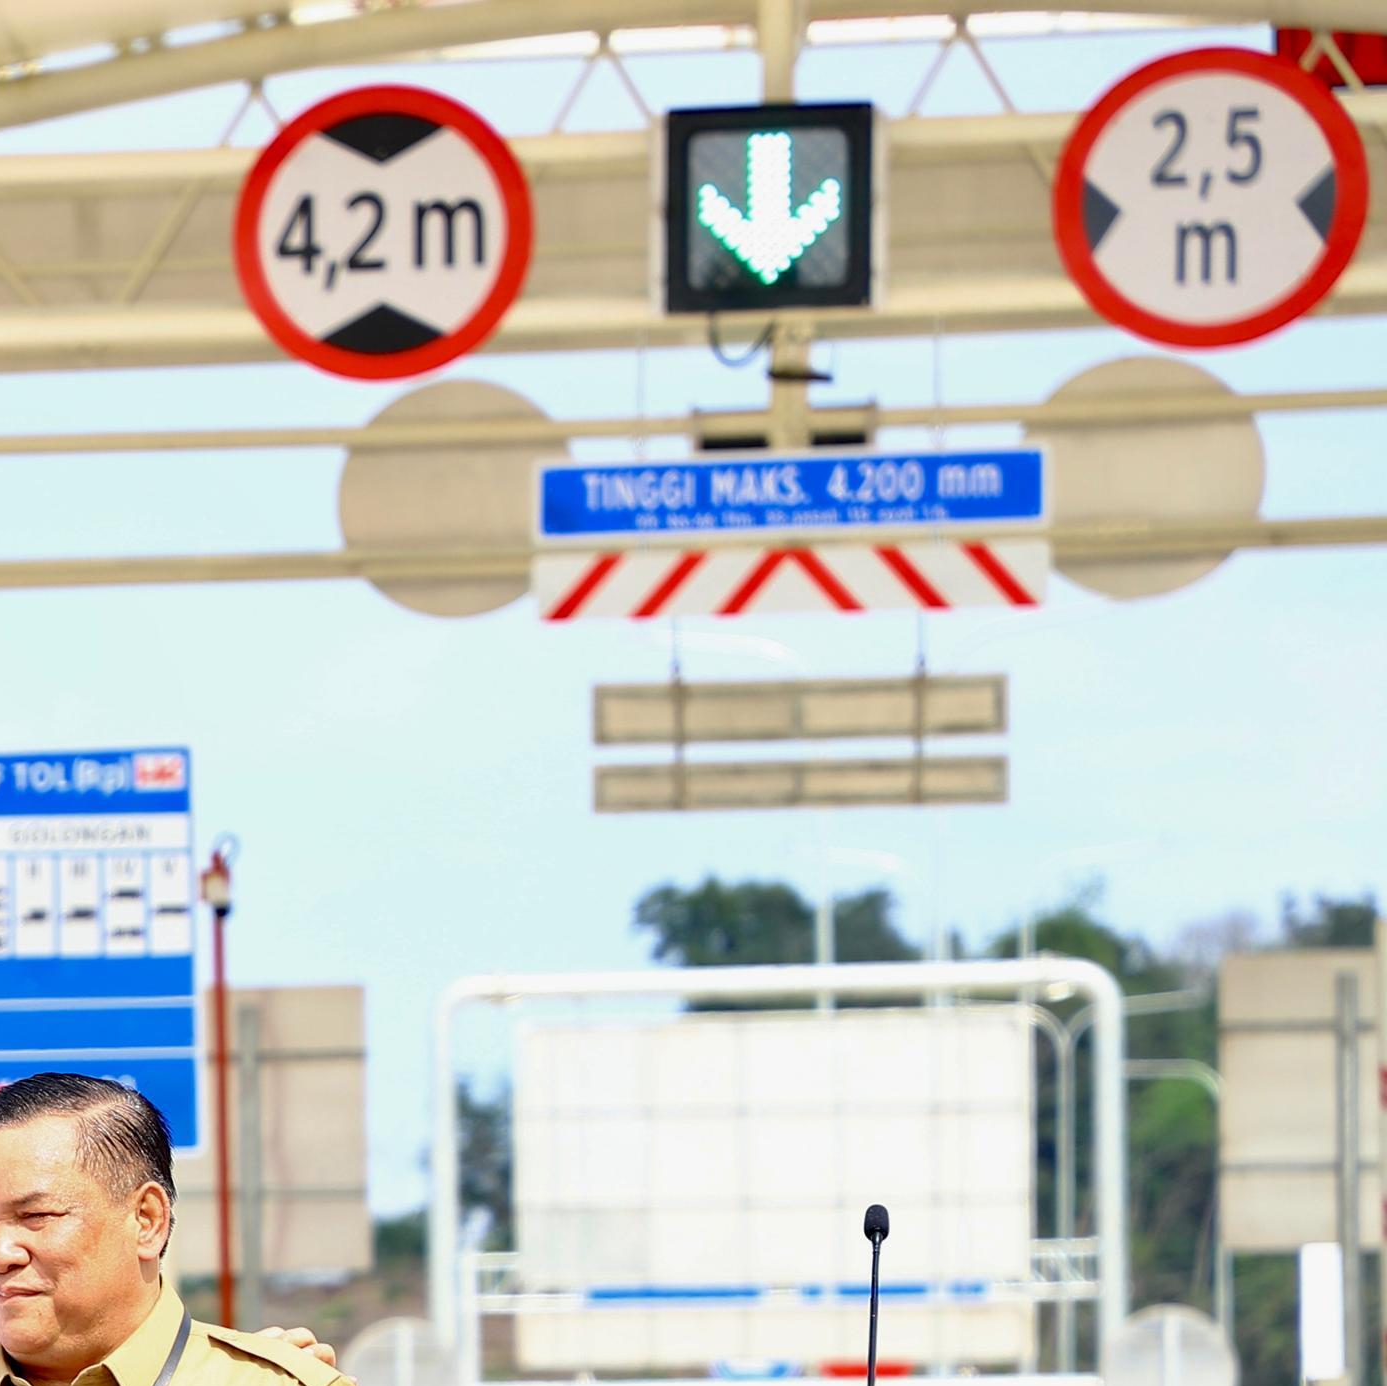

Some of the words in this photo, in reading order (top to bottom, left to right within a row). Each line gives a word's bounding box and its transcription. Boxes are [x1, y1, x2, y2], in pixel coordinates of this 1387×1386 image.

[1151, 107, 1264, 198] 2,5
[274, 191, 388, 288] 4,2
[413, 198, 486, 270] m
[1174, 222, 1238, 285] m
[583, 470, 697, 511] TINGGI
[710, 464, 812, 507] MAKS.
[827, 460, 926, 503] 4.200
[936, 462, 1002, 498] mm
[12, 759, 69, 793] TOL
